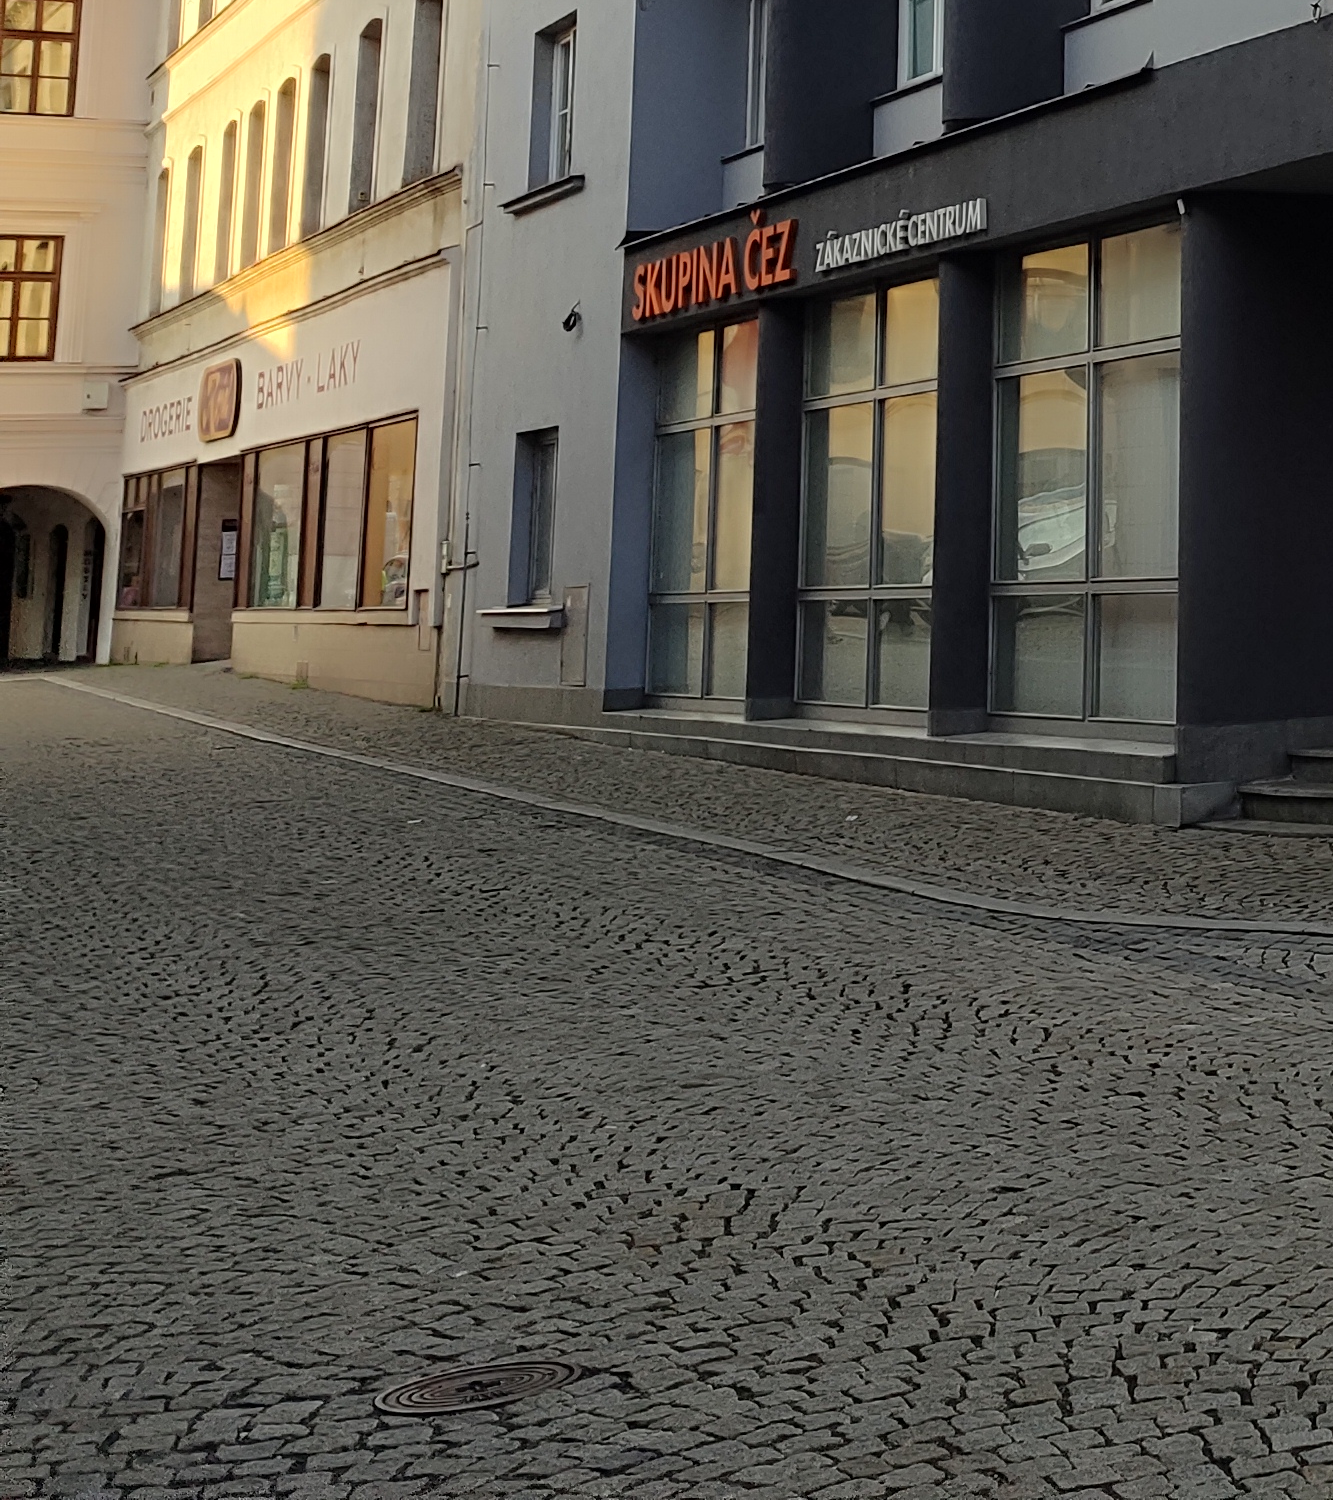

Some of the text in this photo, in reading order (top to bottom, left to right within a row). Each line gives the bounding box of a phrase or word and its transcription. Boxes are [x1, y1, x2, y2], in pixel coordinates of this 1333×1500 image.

[631, 209, 799, 322] SKUPINA ČEZ
[815, 198, 988, 273] ZÁKAZNICKÉ CENTRUM
[140, 396, 193, 443] DROGERIE
[257, 358, 304, 410] BARVY
[316, 339, 361, 394] LAKY
